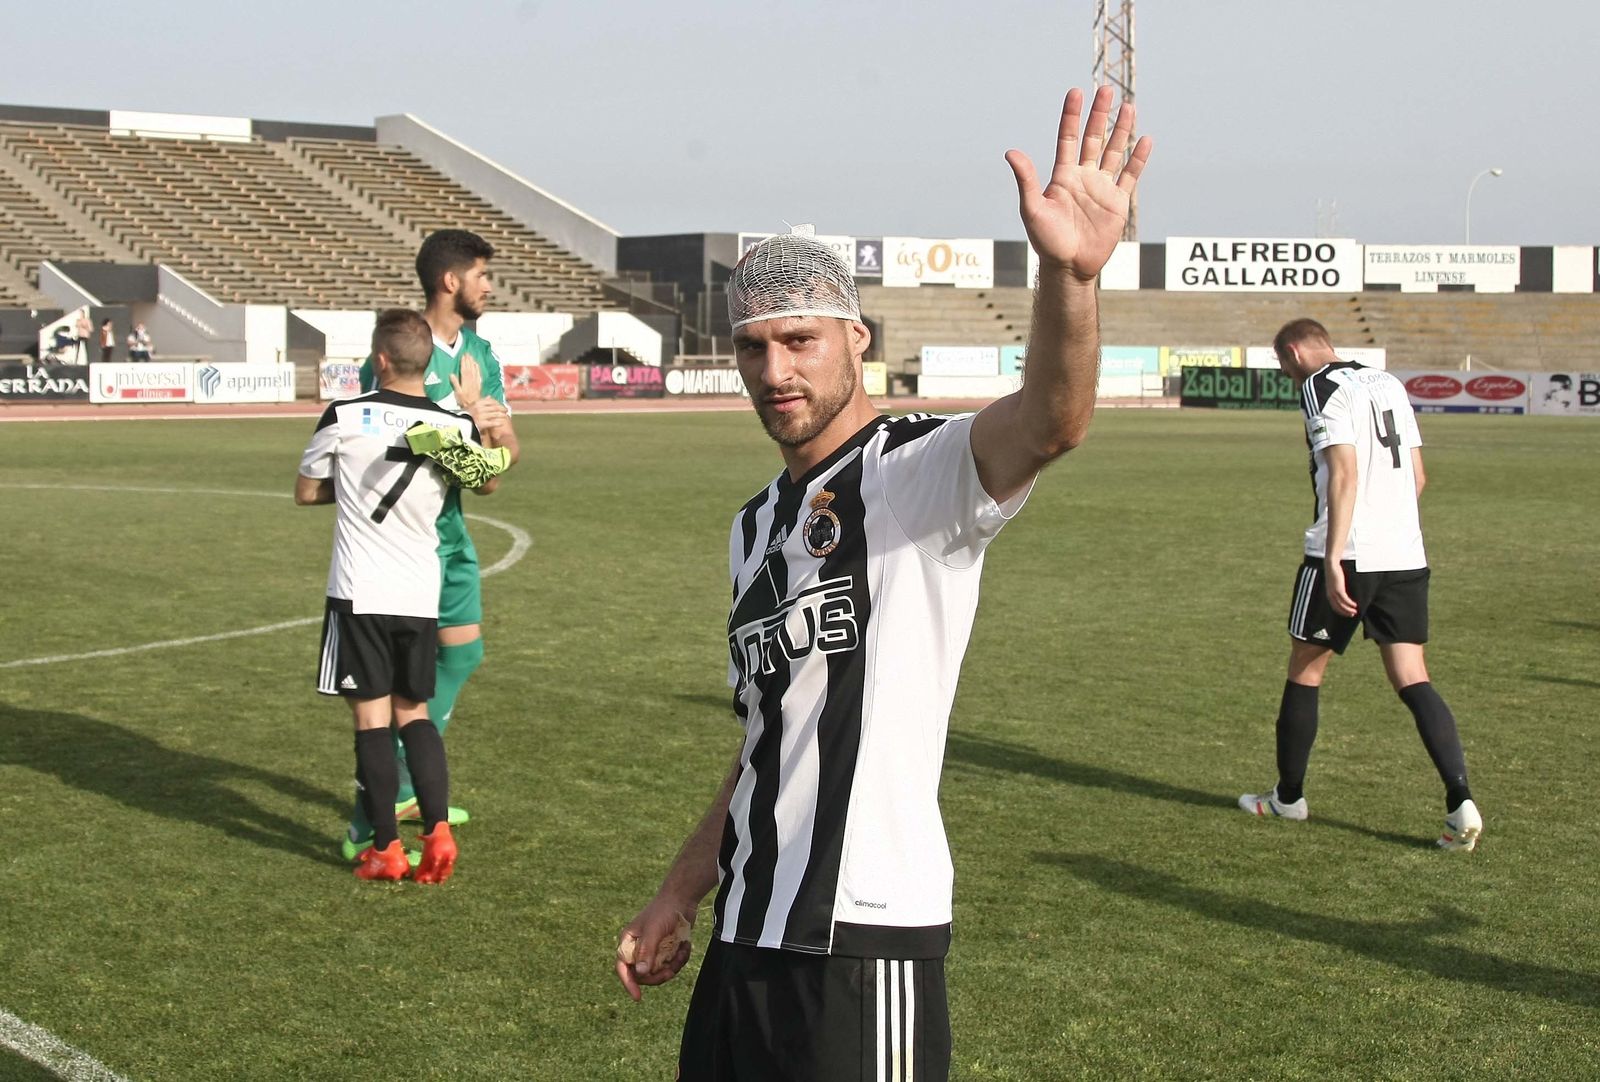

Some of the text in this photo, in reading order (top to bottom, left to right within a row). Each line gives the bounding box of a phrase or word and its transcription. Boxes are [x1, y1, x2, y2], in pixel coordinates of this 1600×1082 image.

[1189, 242, 1336, 263] ALFREDO
[1369, 252, 1516, 265] TERRAZOS Y MARMOLES
[1181, 266, 1340, 287] GALLARDO
[1415, 271, 1466, 283] LINENSE
[26, 364, 49, 379] LA
[98, 366, 187, 398] Universal
[226, 371, 292, 393] apymell
[590, 365, 662, 384] PAQUITA
[684, 369, 748, 396] MARITIMO
[1181, 368, 1300, 399] Zabal Ba
[1370, 399, 1401, 468] 4
[370, 446, 427, 524] 7
[854, 899, 887, 910] climacool
